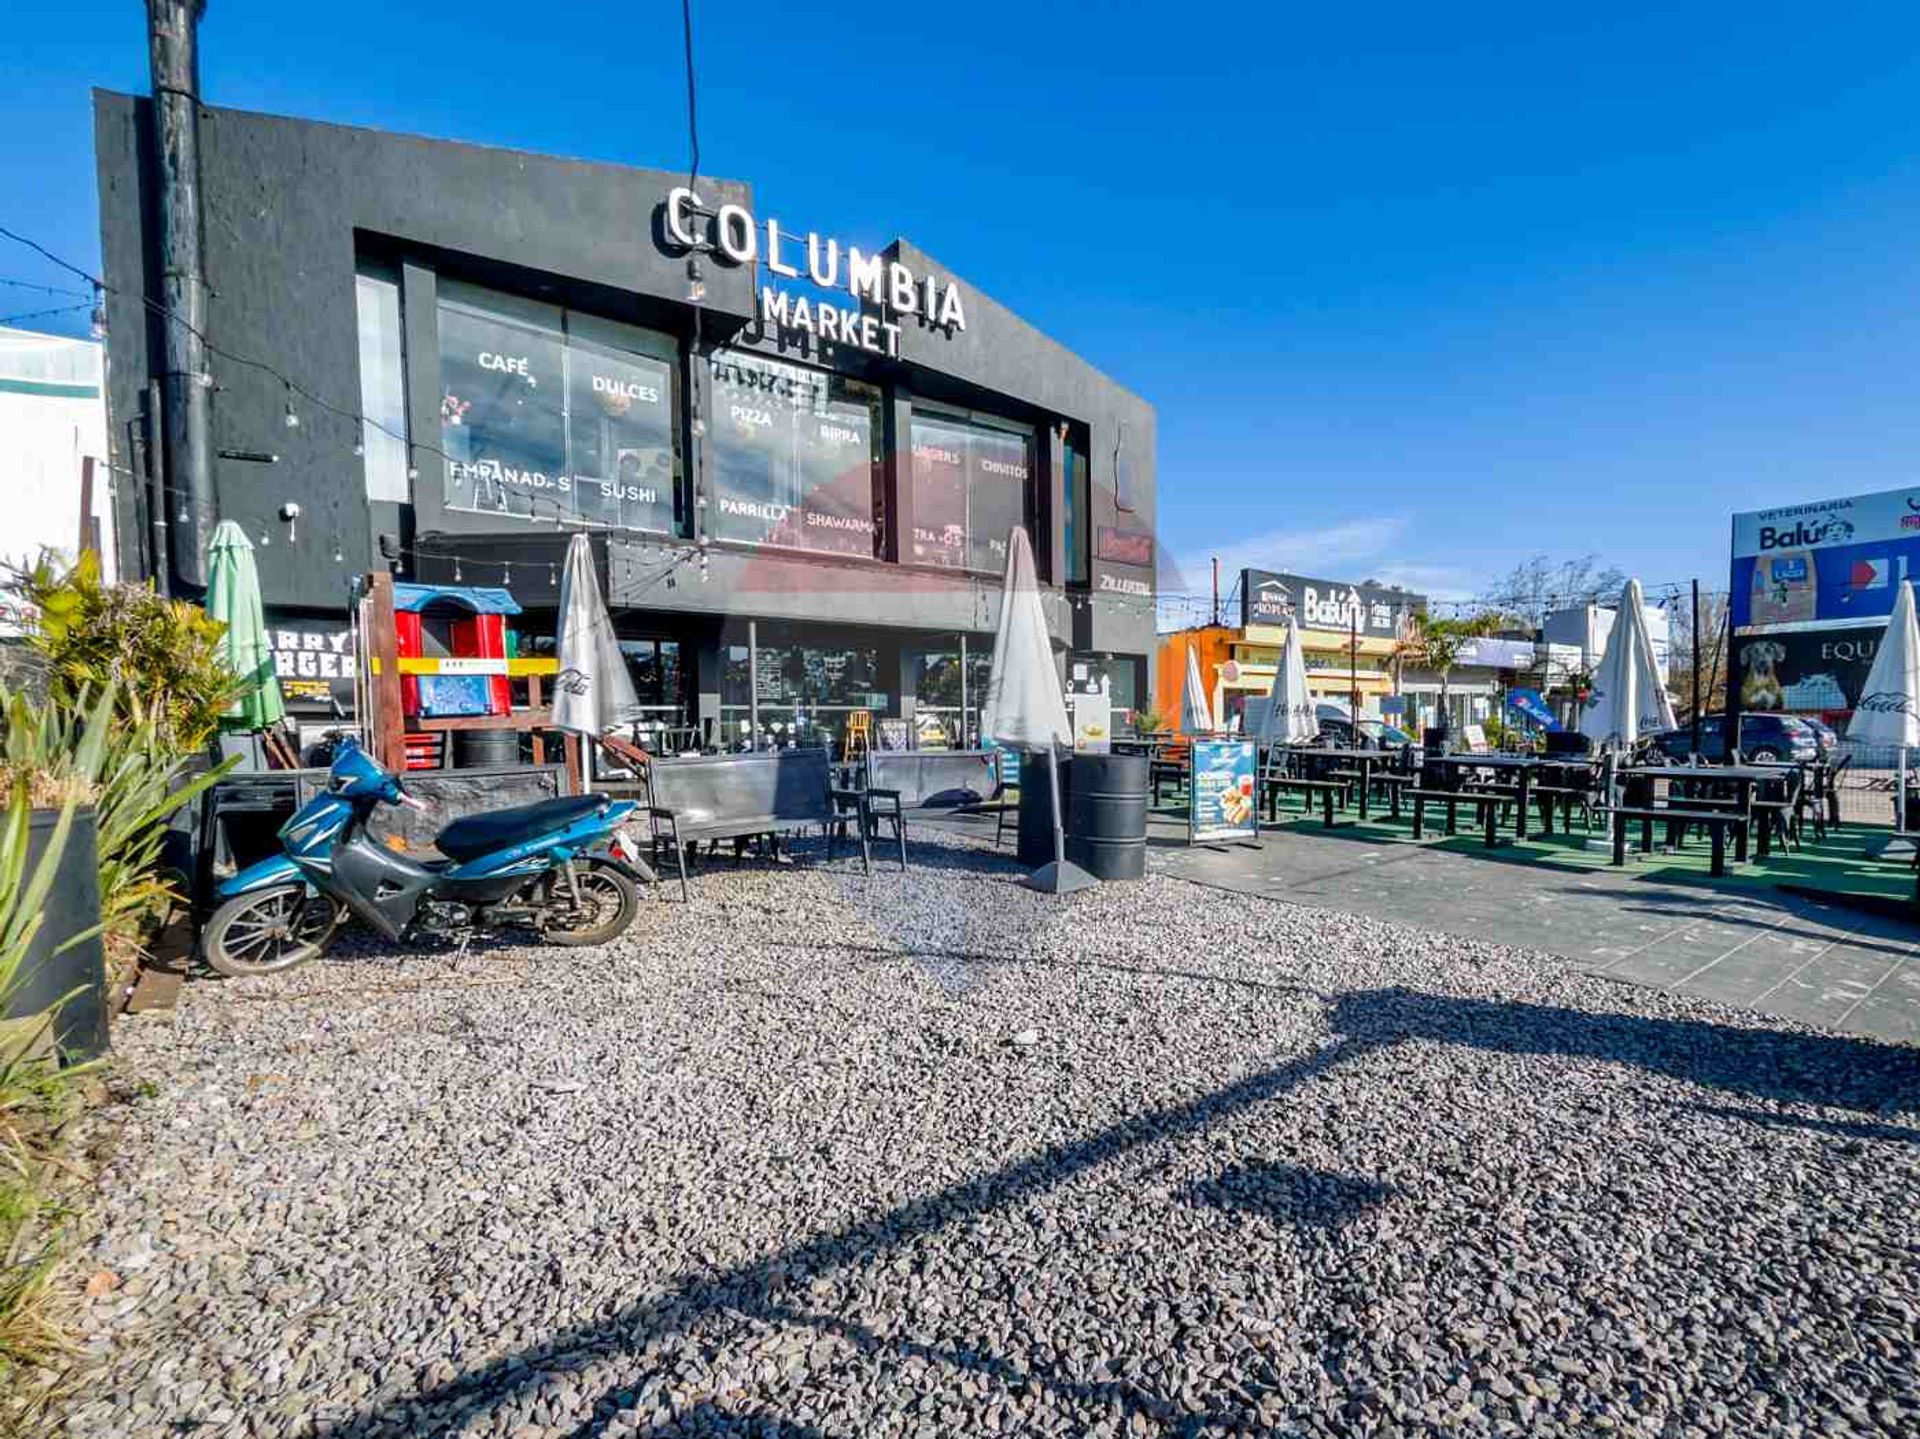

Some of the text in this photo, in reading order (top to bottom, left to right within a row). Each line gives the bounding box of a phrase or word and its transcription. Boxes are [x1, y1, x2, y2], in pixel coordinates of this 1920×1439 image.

[667, 186, 966, 332] COLUMBIA
[762, 285, 901, 358] MARKET
[478, 352, 529, 377] CAFÉ
[591, 374, 659, 403] DULCES
[729, 405, 773, 428] PIZZA
[600, 481, 657, 503] SUSHI
[1757, 499, 1854, 521] VETERINARIA
[1759, 521, 1822, 550] Balú
